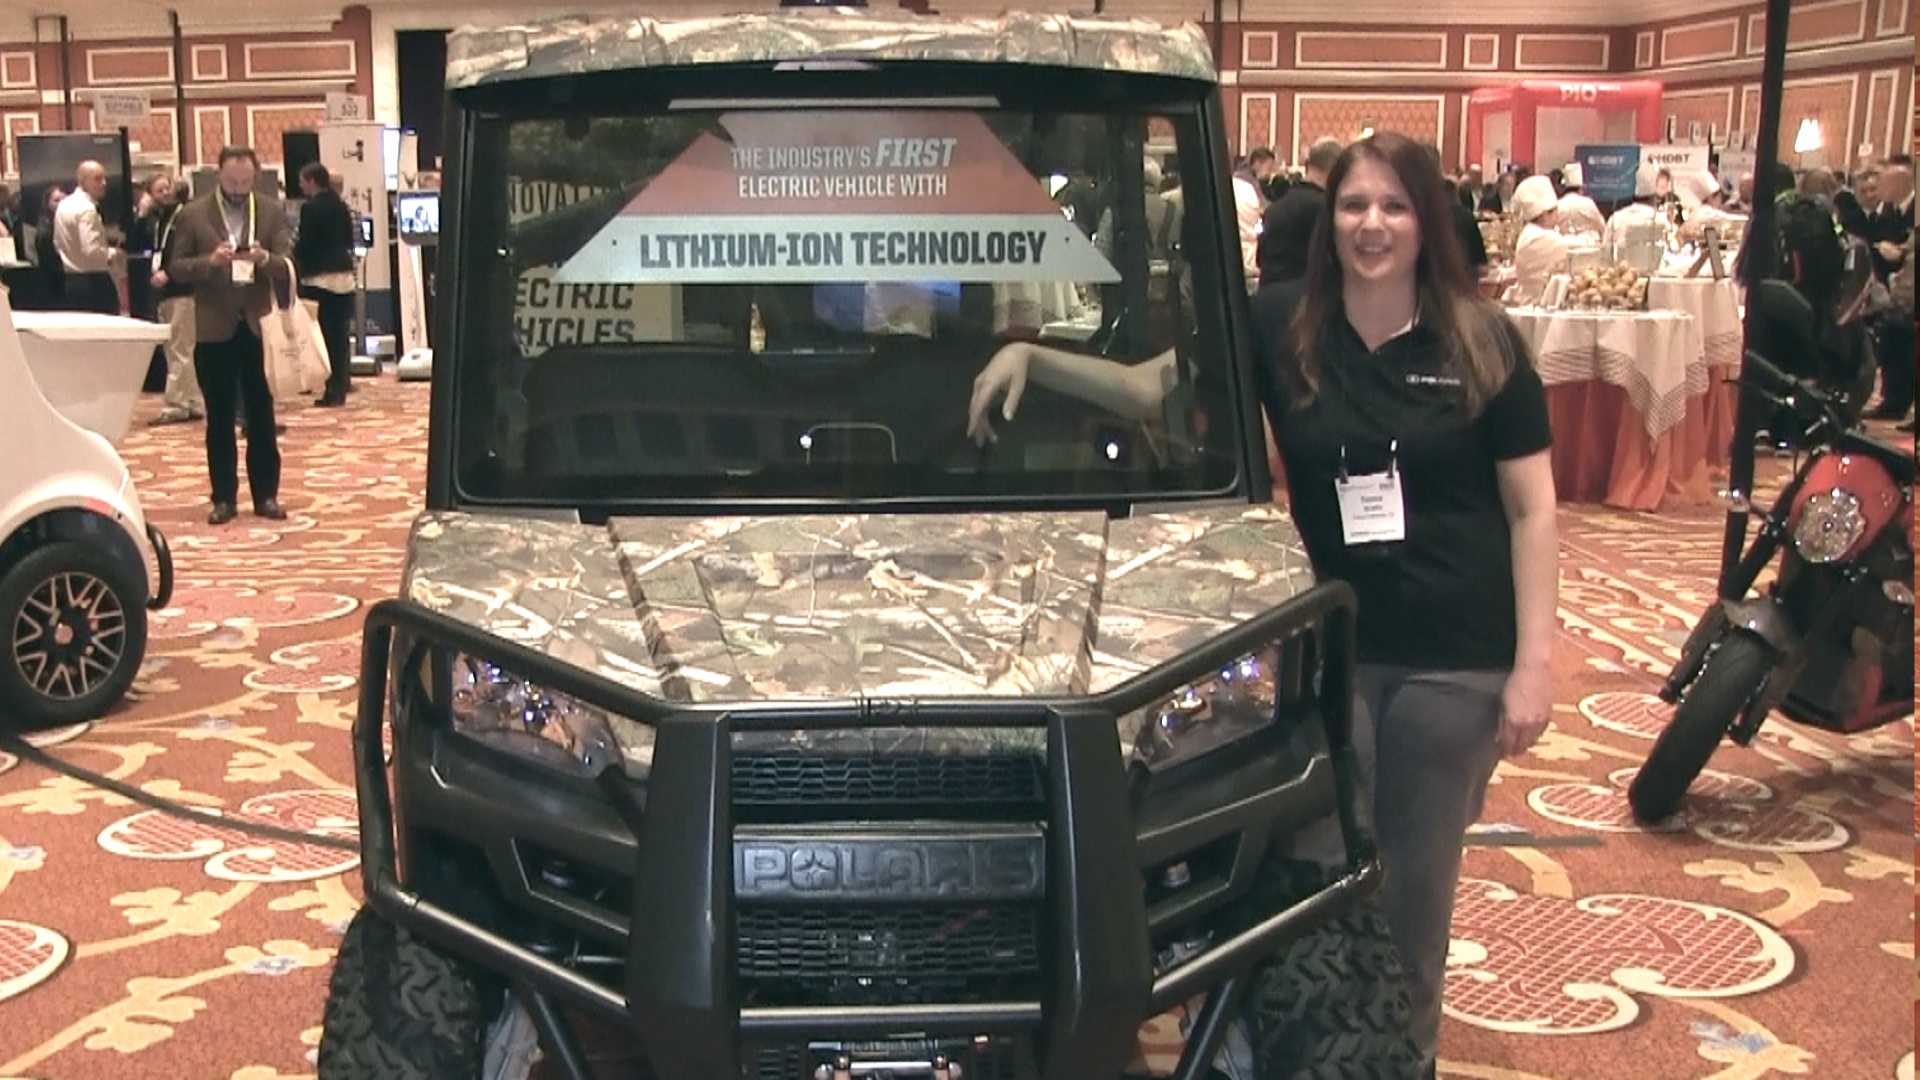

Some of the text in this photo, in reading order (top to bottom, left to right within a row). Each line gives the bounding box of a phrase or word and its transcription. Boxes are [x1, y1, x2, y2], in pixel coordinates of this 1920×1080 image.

[731, 137, 957, 169] THE INDUSTRY'S FIRST
[738, 173, 947, 198] ELECTRIC VEHICLE WITH
[640, 230, 1047, 268] LITHIUM-ION TECHNOLOGY
[741, 843, 1038, 890] POLARIS
